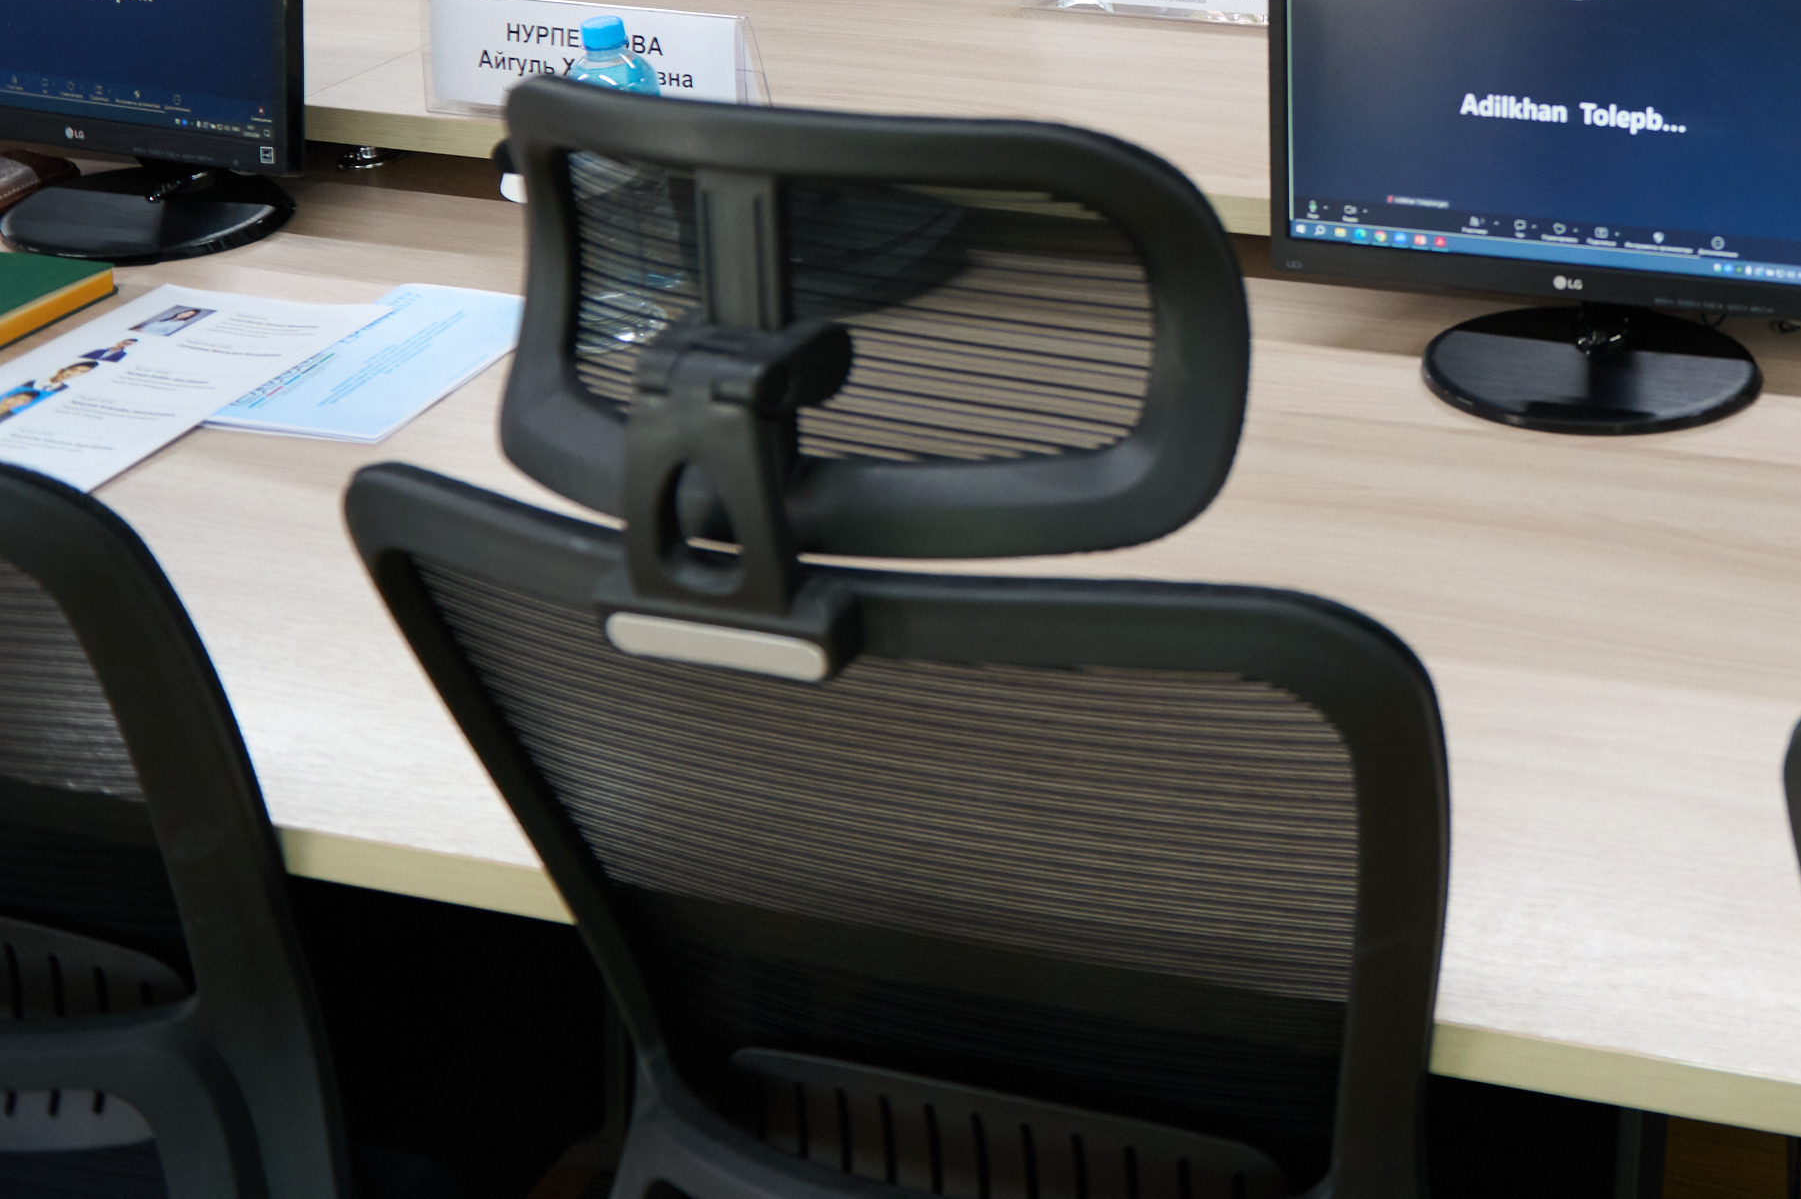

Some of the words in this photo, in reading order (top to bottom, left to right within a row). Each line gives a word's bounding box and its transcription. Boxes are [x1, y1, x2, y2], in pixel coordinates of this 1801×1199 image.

[505, 22, 663, 57] НУРПЕВА
[477, 49, 555, 77] Айгуль
[1459, 92, 1568, 124] Adilkhan
[1579, 101, 1687, 135] Tolepb...
